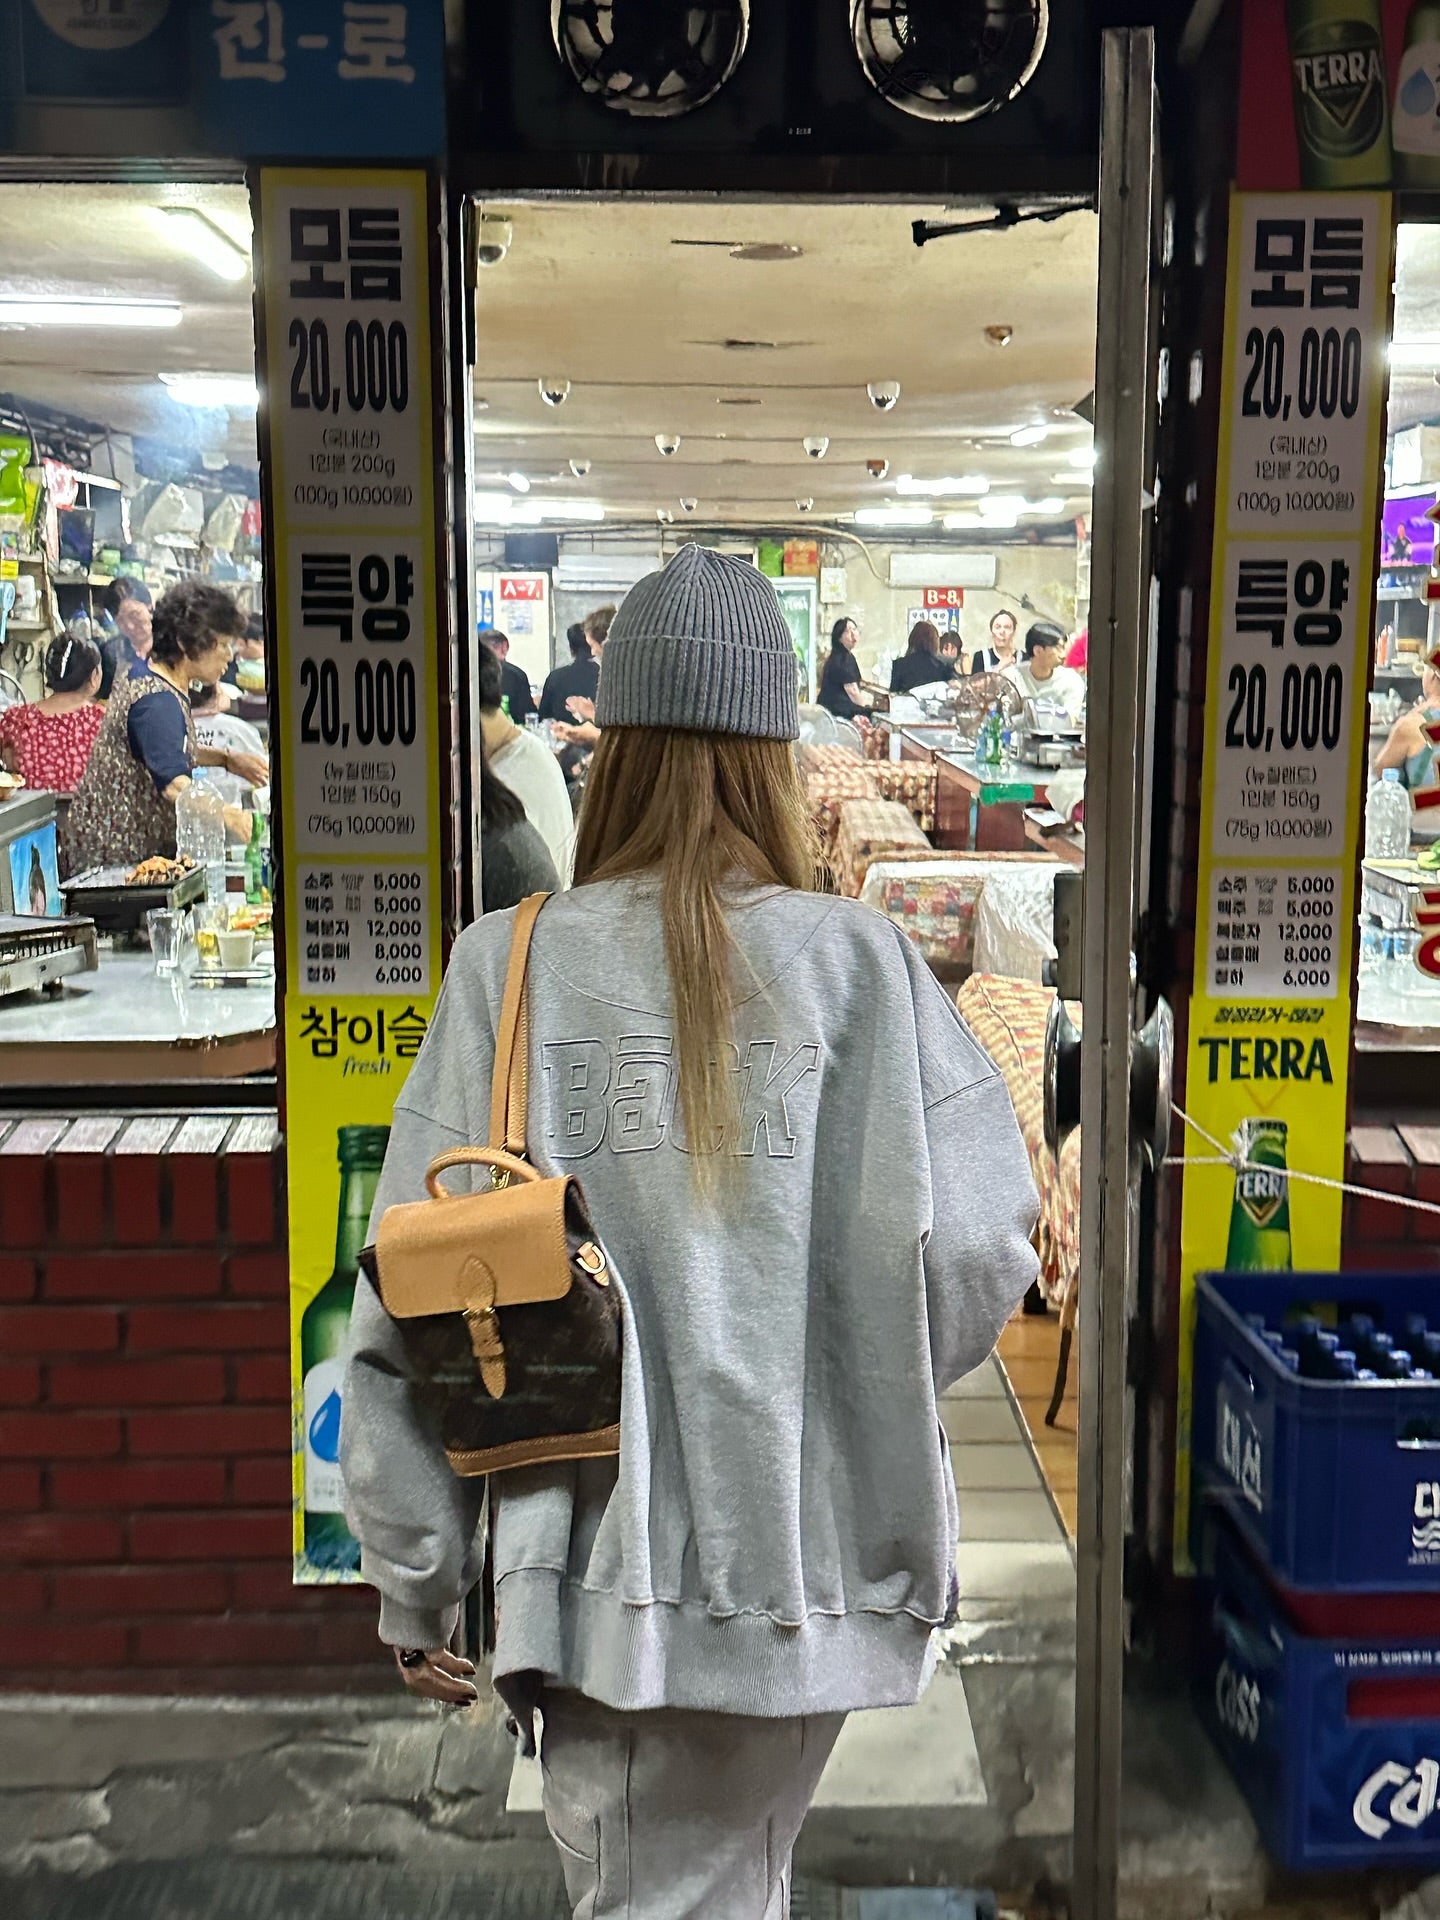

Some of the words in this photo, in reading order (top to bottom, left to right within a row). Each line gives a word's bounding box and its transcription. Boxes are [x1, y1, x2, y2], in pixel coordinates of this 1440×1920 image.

[1295, 49, 1382, 93] TERRA
[290, 208, 402, 301] 모듬
[1251, 218, 1363, 309] 모듬
[289, 317, 409, 414] 20,000
[1242, 326, 1361, 421] 20,000
[351, 453, 395, 479] 200g
[1296, 459, 1340, 484] 200g
[294, 485, 339, 508] (100g
[1237, 491, 1280, 516] (100g
[301, 554, 414, 643] 특양
[1235, 558, 1349, 649] 특양
[300, 656, 417, 748] 20,000
[1225, 662, 1343, 752] 20,000
[362, 784, 401, 808] 150g
[1282, 789, 1320, 813] 150g
[307, 814, 343, 838] (75g
[1225, 819, 1260, 842] (75g
[304, 872, 334, 890] 소주
[366, 919, 421, 938] 12,000
[1278, 922, 1333, 941] 12,000
[375, 942, 422, 961] 8,000
[1284, 945, 1332, 964] 8,000
[376, 965, 422, 985] 6,000
[1282, 968, 1330, 987] 6,000
[299, 1004, 427, 1057] 참이슬
[342, 1055, 391, 1078] fresh
[1198, 1036, 1334, 1086] TERRA
